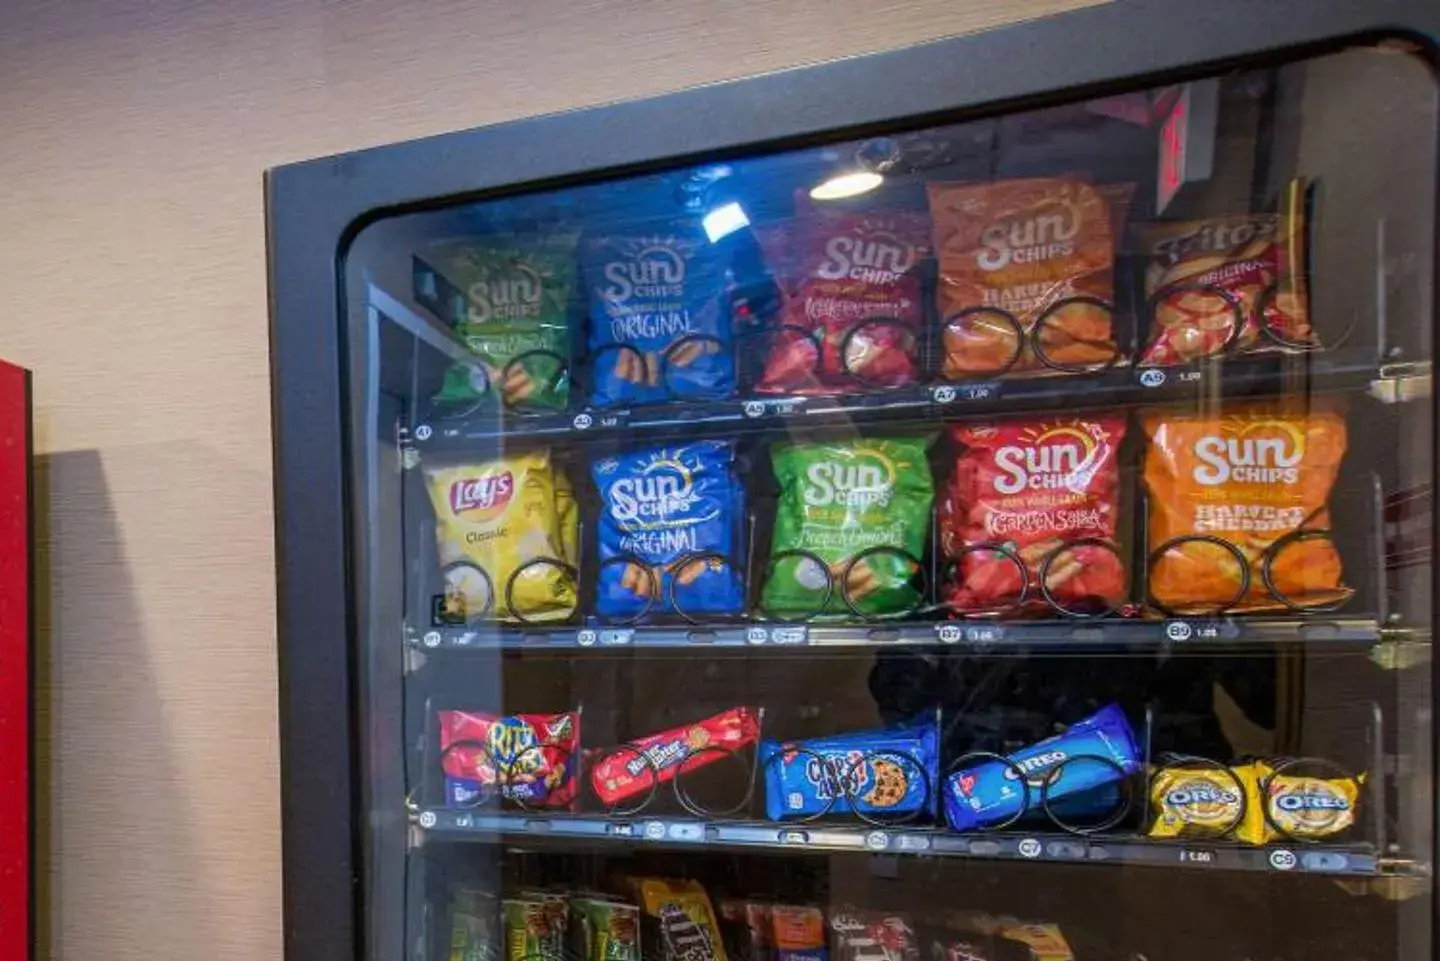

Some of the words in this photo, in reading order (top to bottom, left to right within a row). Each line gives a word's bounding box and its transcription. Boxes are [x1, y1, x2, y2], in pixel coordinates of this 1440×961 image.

[819, 236, 911, 279] Sun
[977, 213, 1078, 271] Sun
[468, 278, 540, 324] Sun
[605, 258, 684, 301] Sun
[634, 285, 683, 297] CHIPS
[612, 311, 700, 341] ORIGINAL
[994, 446, 1092, 493] Sun
[1193, 436, 1304, 484] Sun
[1232, 467, 1298, 484] CHIPS
[611, 476, 692, 519] Sun
[804, 462, 890, 506] Sun
[1168, 788, 1236, 804] OREO
[1278, 795, 1348, 810] OREO
